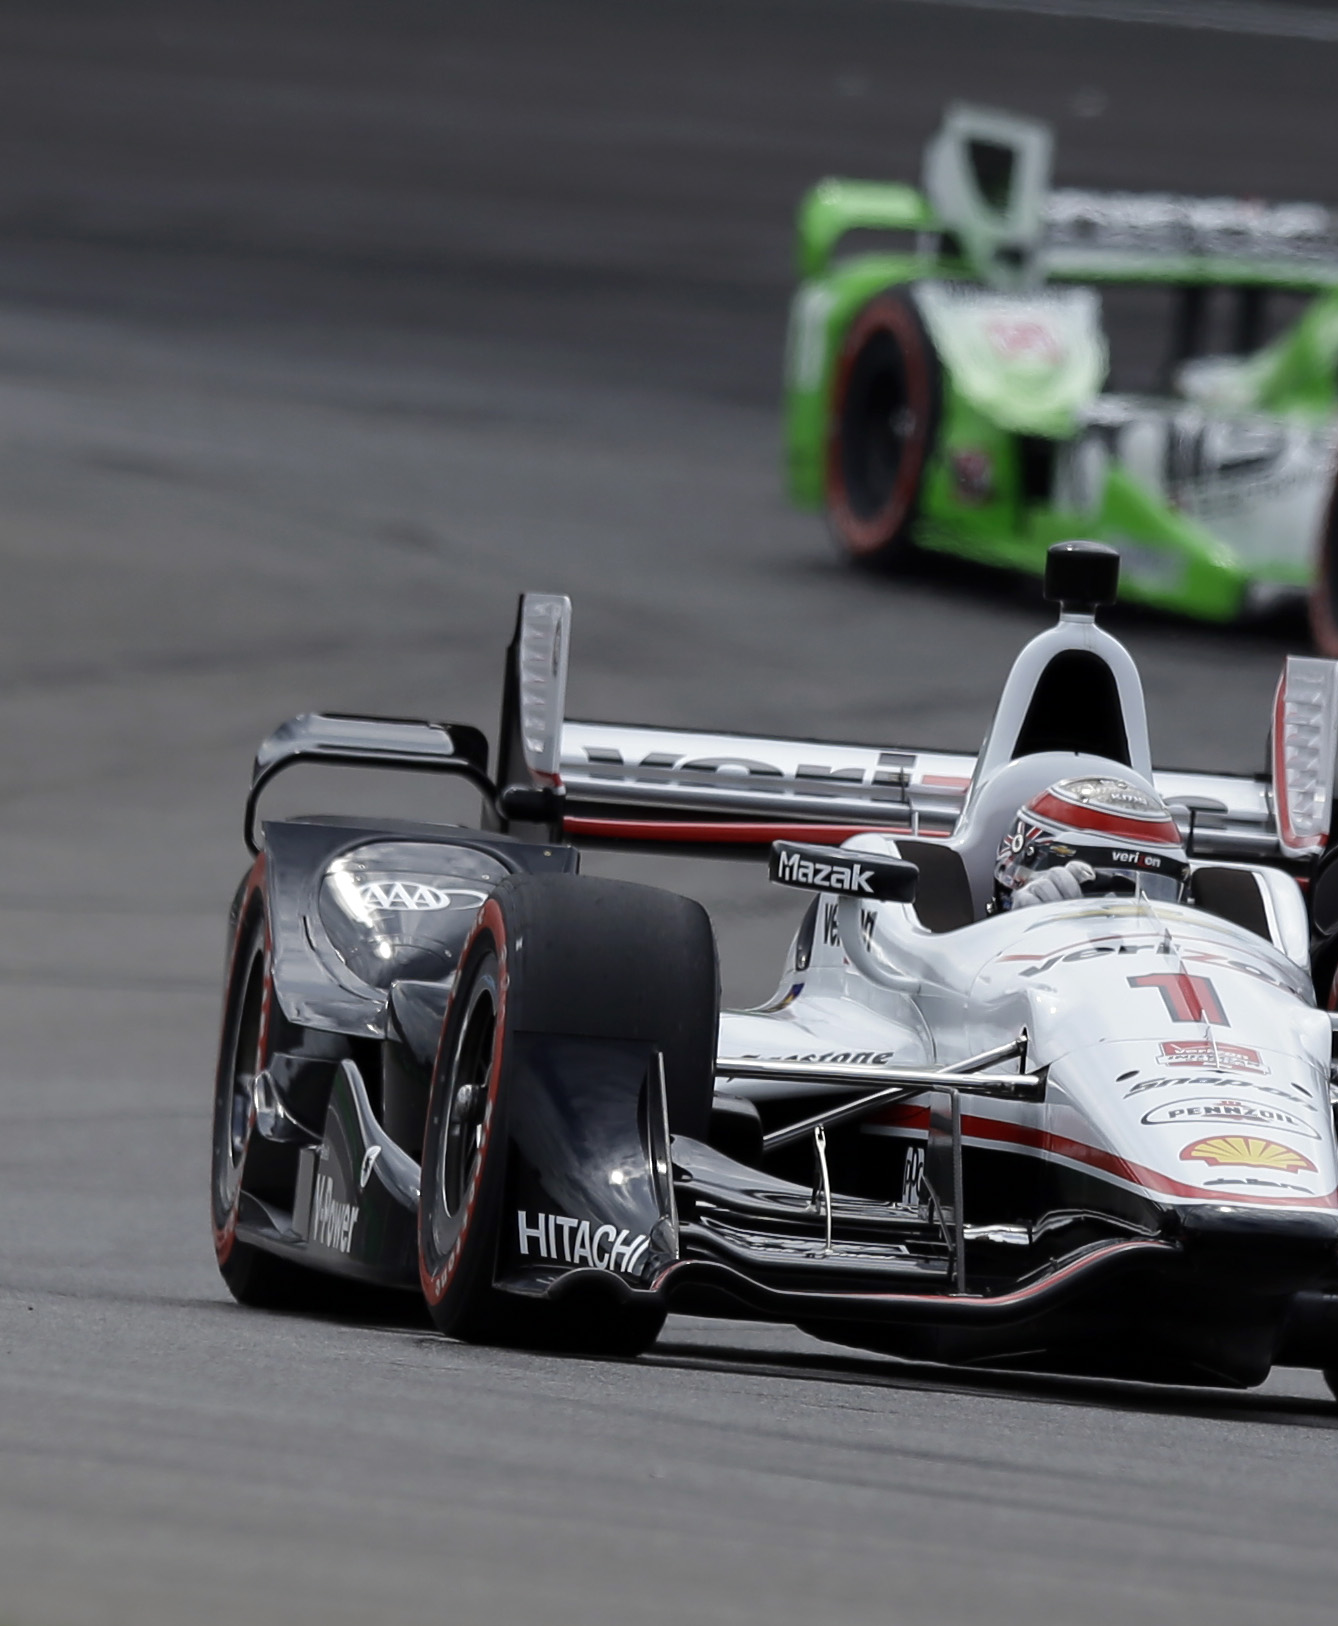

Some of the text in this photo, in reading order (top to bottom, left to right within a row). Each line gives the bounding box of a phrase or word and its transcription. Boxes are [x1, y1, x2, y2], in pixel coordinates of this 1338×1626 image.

[778, 850, 875, 893] Mazak
[1126, 973, 1231, 1028] 1
[1167, 1104, 1300, 1126] PENNZOIL
[518, 1210, 650, 1273] HITACHI
